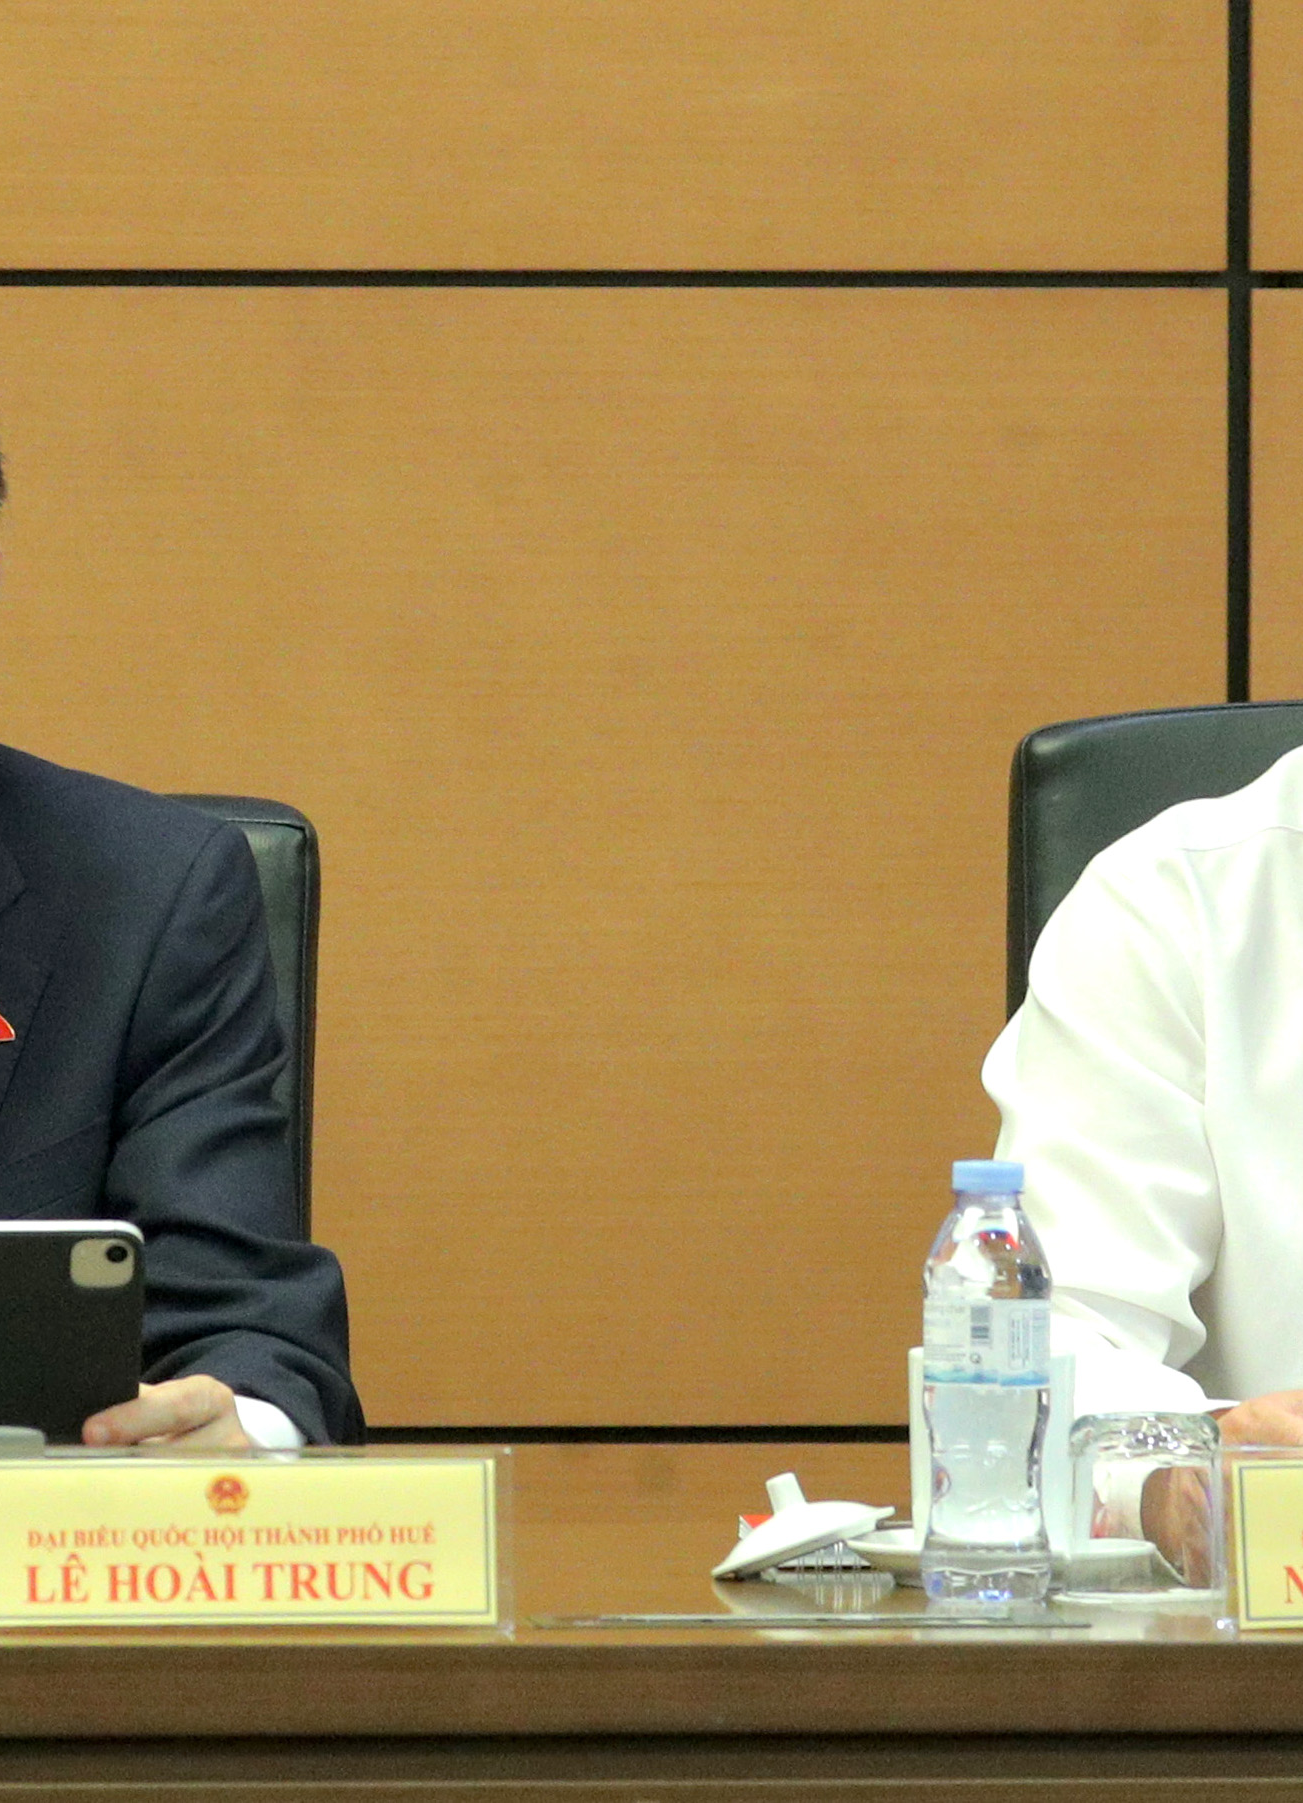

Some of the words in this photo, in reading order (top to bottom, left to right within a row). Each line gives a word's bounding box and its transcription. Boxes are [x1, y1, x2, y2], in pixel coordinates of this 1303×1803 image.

[27, 1529, 67, 1550] ĐẠI
[74, 1524, 126, 1547] BIỂU
[132, 1523, 198, 1549] QUỐC
[205, 1528, 245, 1549] HỘI
[252, 1521, 330, 1545] THÀNH
[337, 1522, 385, 1545] PHỐ
[390, 1521, 436, 1543] HUẾ
[25, 1553, 89, 1603] LÊ
[107, 1551, 236, 1603] HOÀI
[253, 1561, 435, 1601] TRUNG
